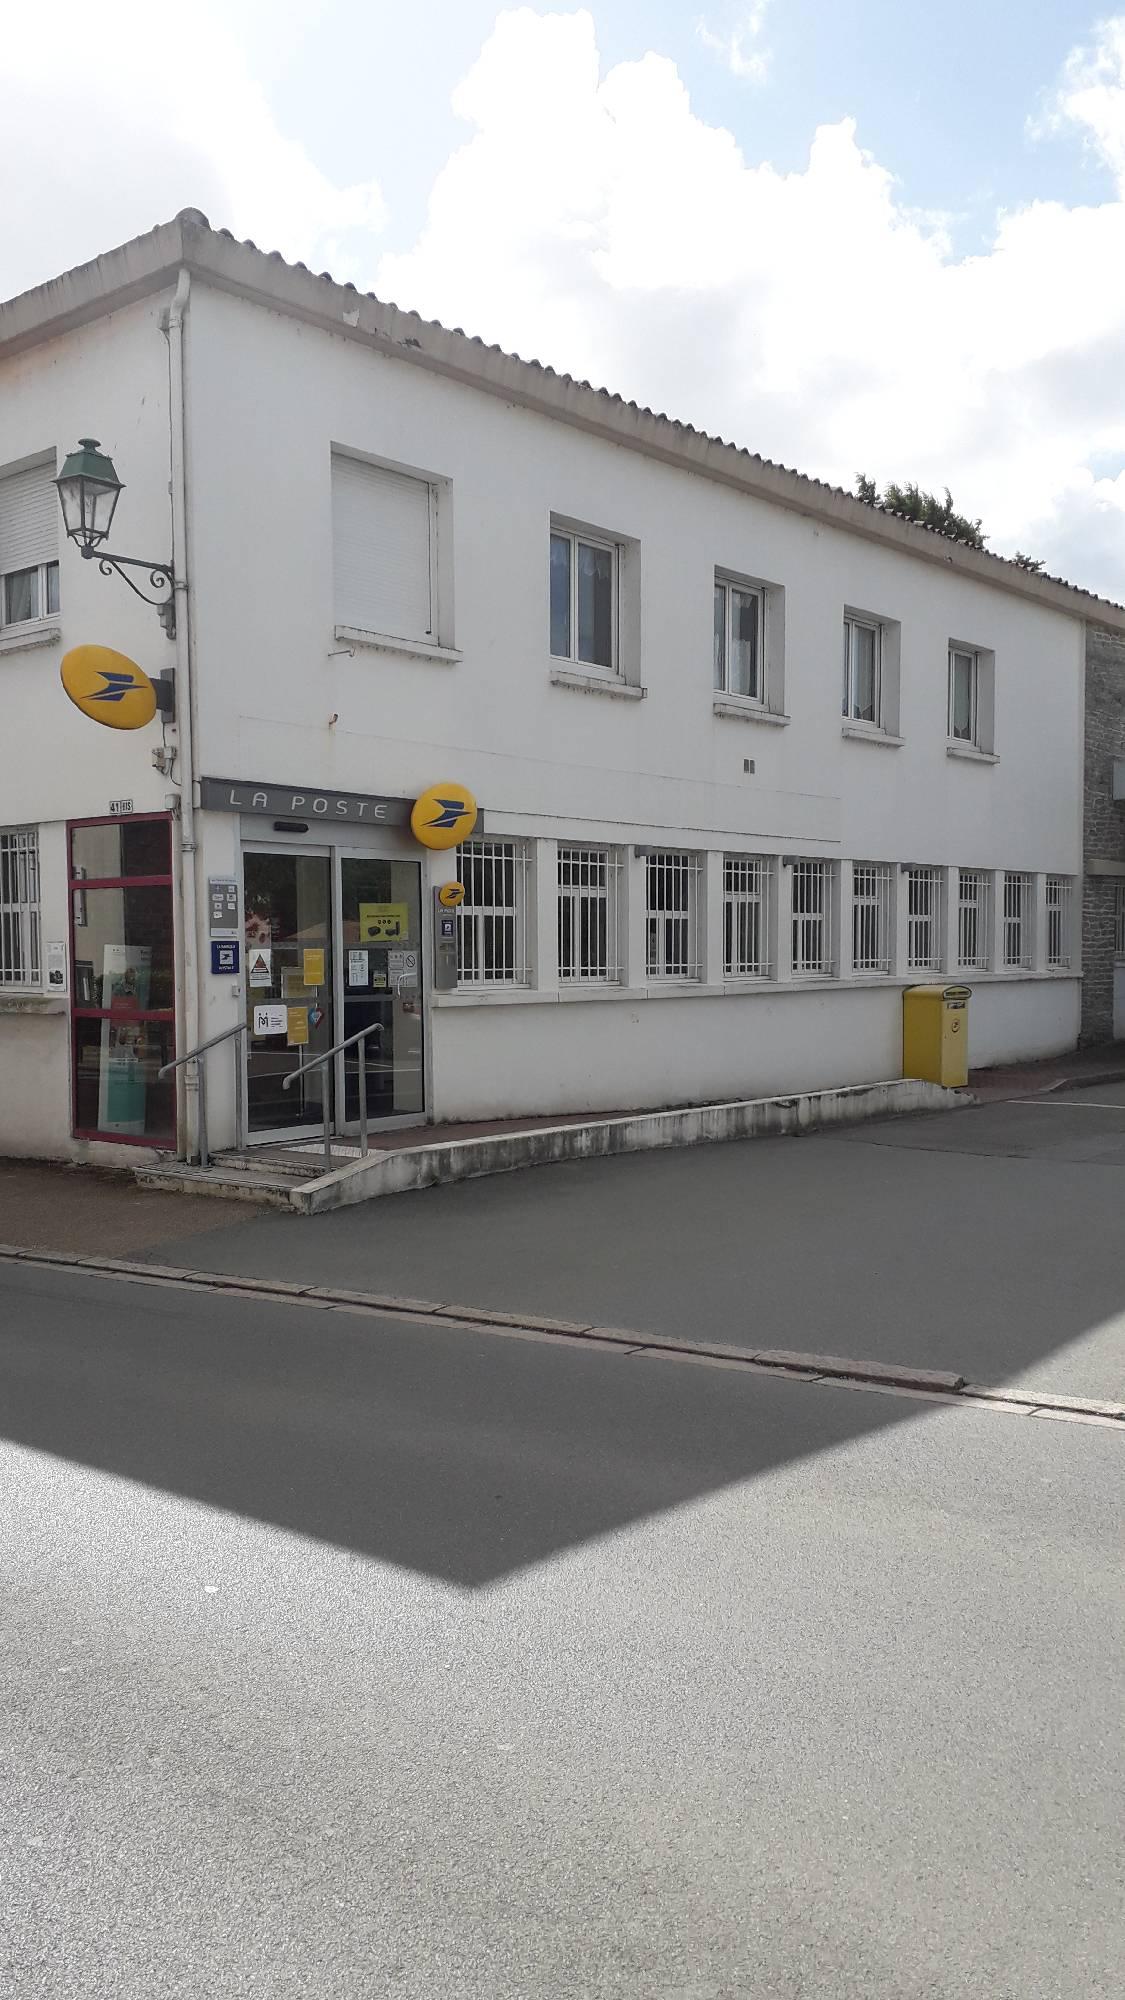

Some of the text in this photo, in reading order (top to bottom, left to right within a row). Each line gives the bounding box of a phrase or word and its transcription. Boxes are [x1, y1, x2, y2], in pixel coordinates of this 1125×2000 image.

[110, 802, 119, 812] 41
[229, 789, 388, 819] LA POSTE
